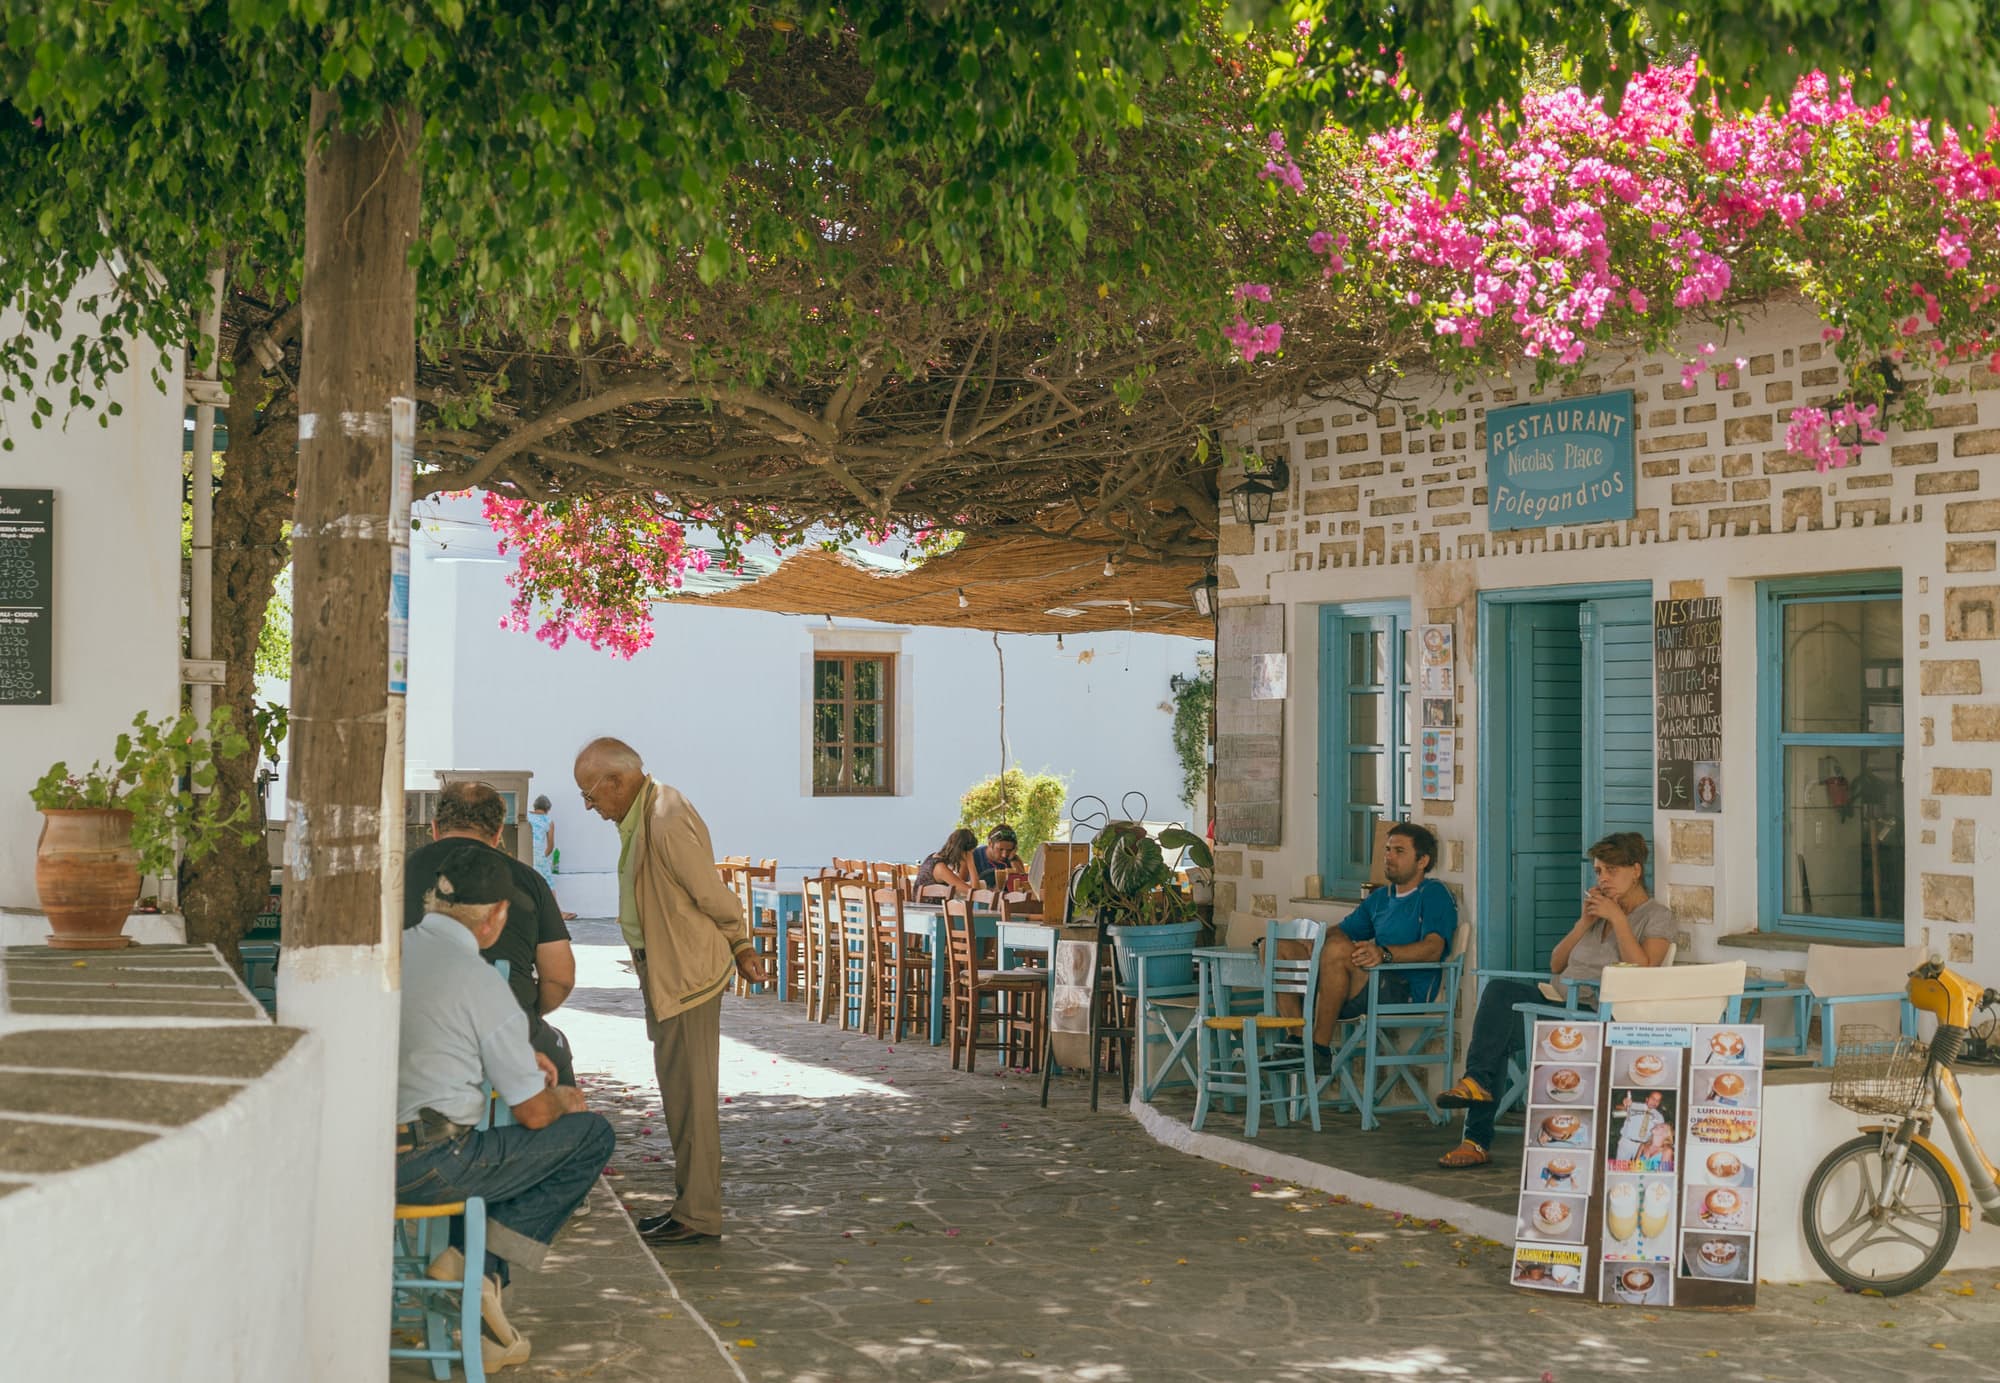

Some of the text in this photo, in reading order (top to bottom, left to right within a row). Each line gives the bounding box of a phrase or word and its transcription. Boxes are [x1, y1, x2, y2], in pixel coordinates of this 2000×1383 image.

[1493, 410, 1626, 456] RESTAURANT
[1564, 442, 1604, 470] Place
[1494, 471, 1625, 521] Folegandros
[1658, 650, 1672, 671] 40
[1674, 649, 1696, 668] KINDS
[1705, 646, 1722, 664] TEA
[1656, 696, 1666, 720] 5
[1658, 714, 1722, 738] MARMELADES
[1697, 1107, 1753, 1116] LUKUMADES
